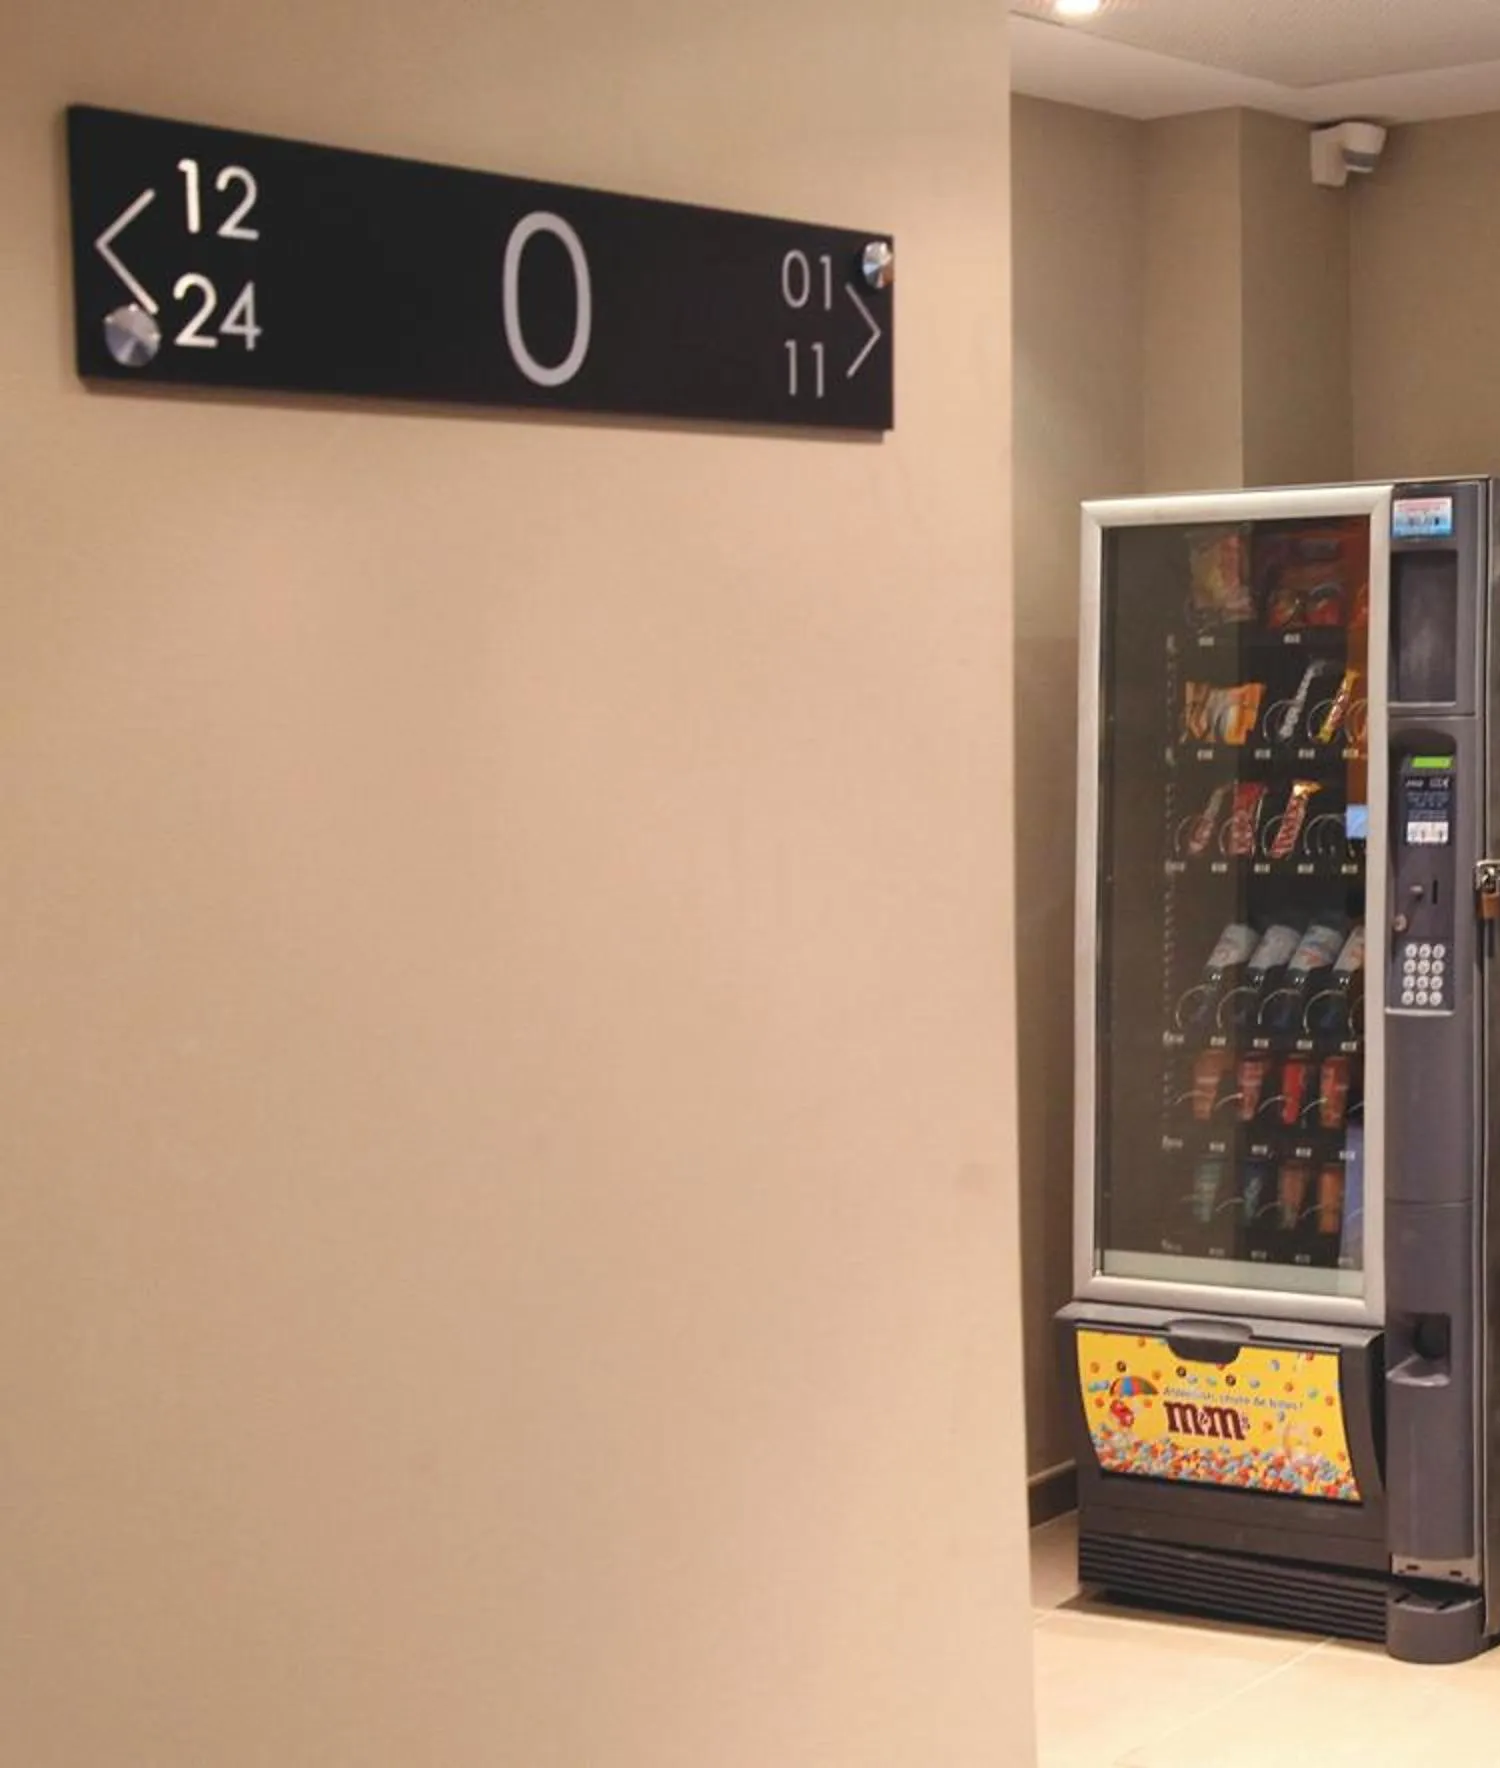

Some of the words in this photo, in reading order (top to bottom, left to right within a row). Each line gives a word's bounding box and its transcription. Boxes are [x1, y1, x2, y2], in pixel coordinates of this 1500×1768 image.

[178, 158, 258, 239] 12
[173, 273, 261, 350] 24
[503, 211, 592, 386] 0
[782, 249, 833, 311] 01
[785, 340, 824, 397] 11
